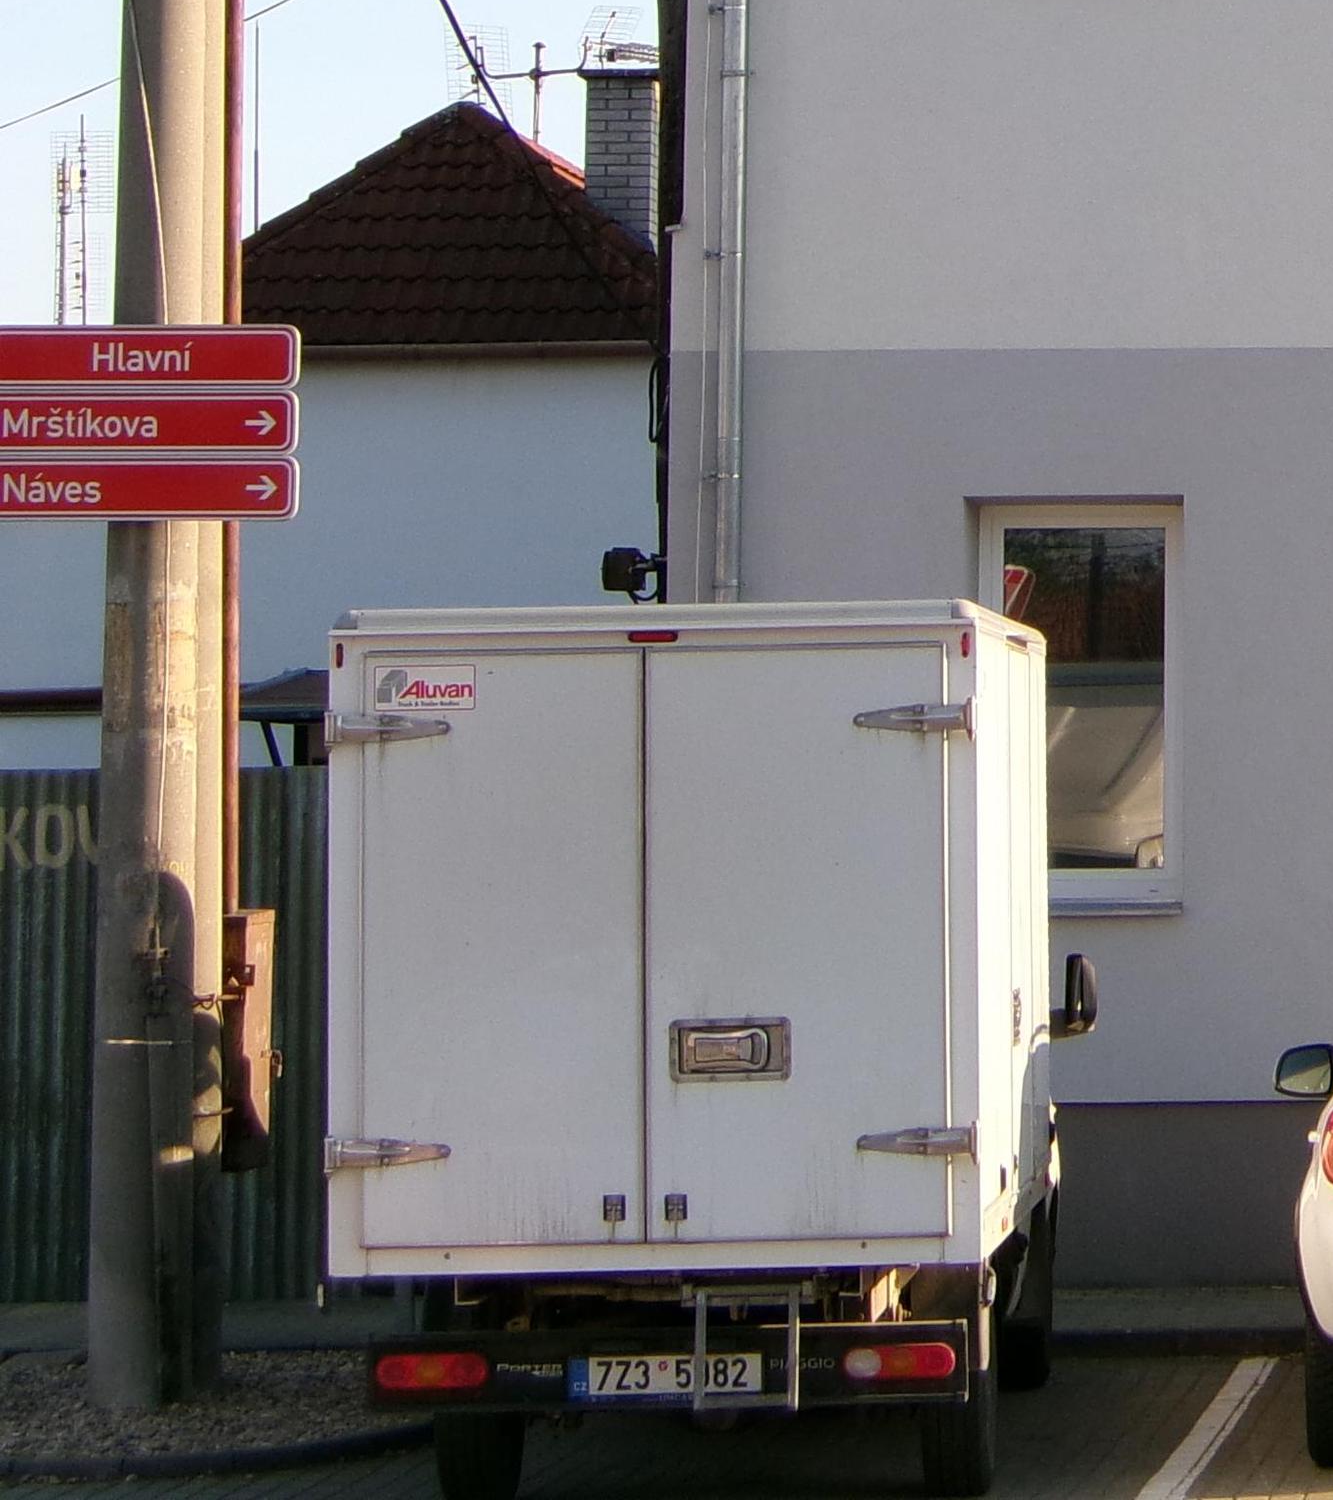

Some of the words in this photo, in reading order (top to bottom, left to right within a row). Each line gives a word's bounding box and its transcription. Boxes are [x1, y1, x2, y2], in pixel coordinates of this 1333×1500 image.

[92, 341, 193, 372] Hlavní
[2, 407, 158, 438] Mrštíkova
[3, 472, 101, 503] Náves
[399, 680, 473, 699] Aluvan
[573, 1382, 587, 1392] CZ
[596, 1360, 650, 1391] 7Z3
[675, 1357, 748, 1388] 582
[769, 1356, 835, 1370] PIGGIO
